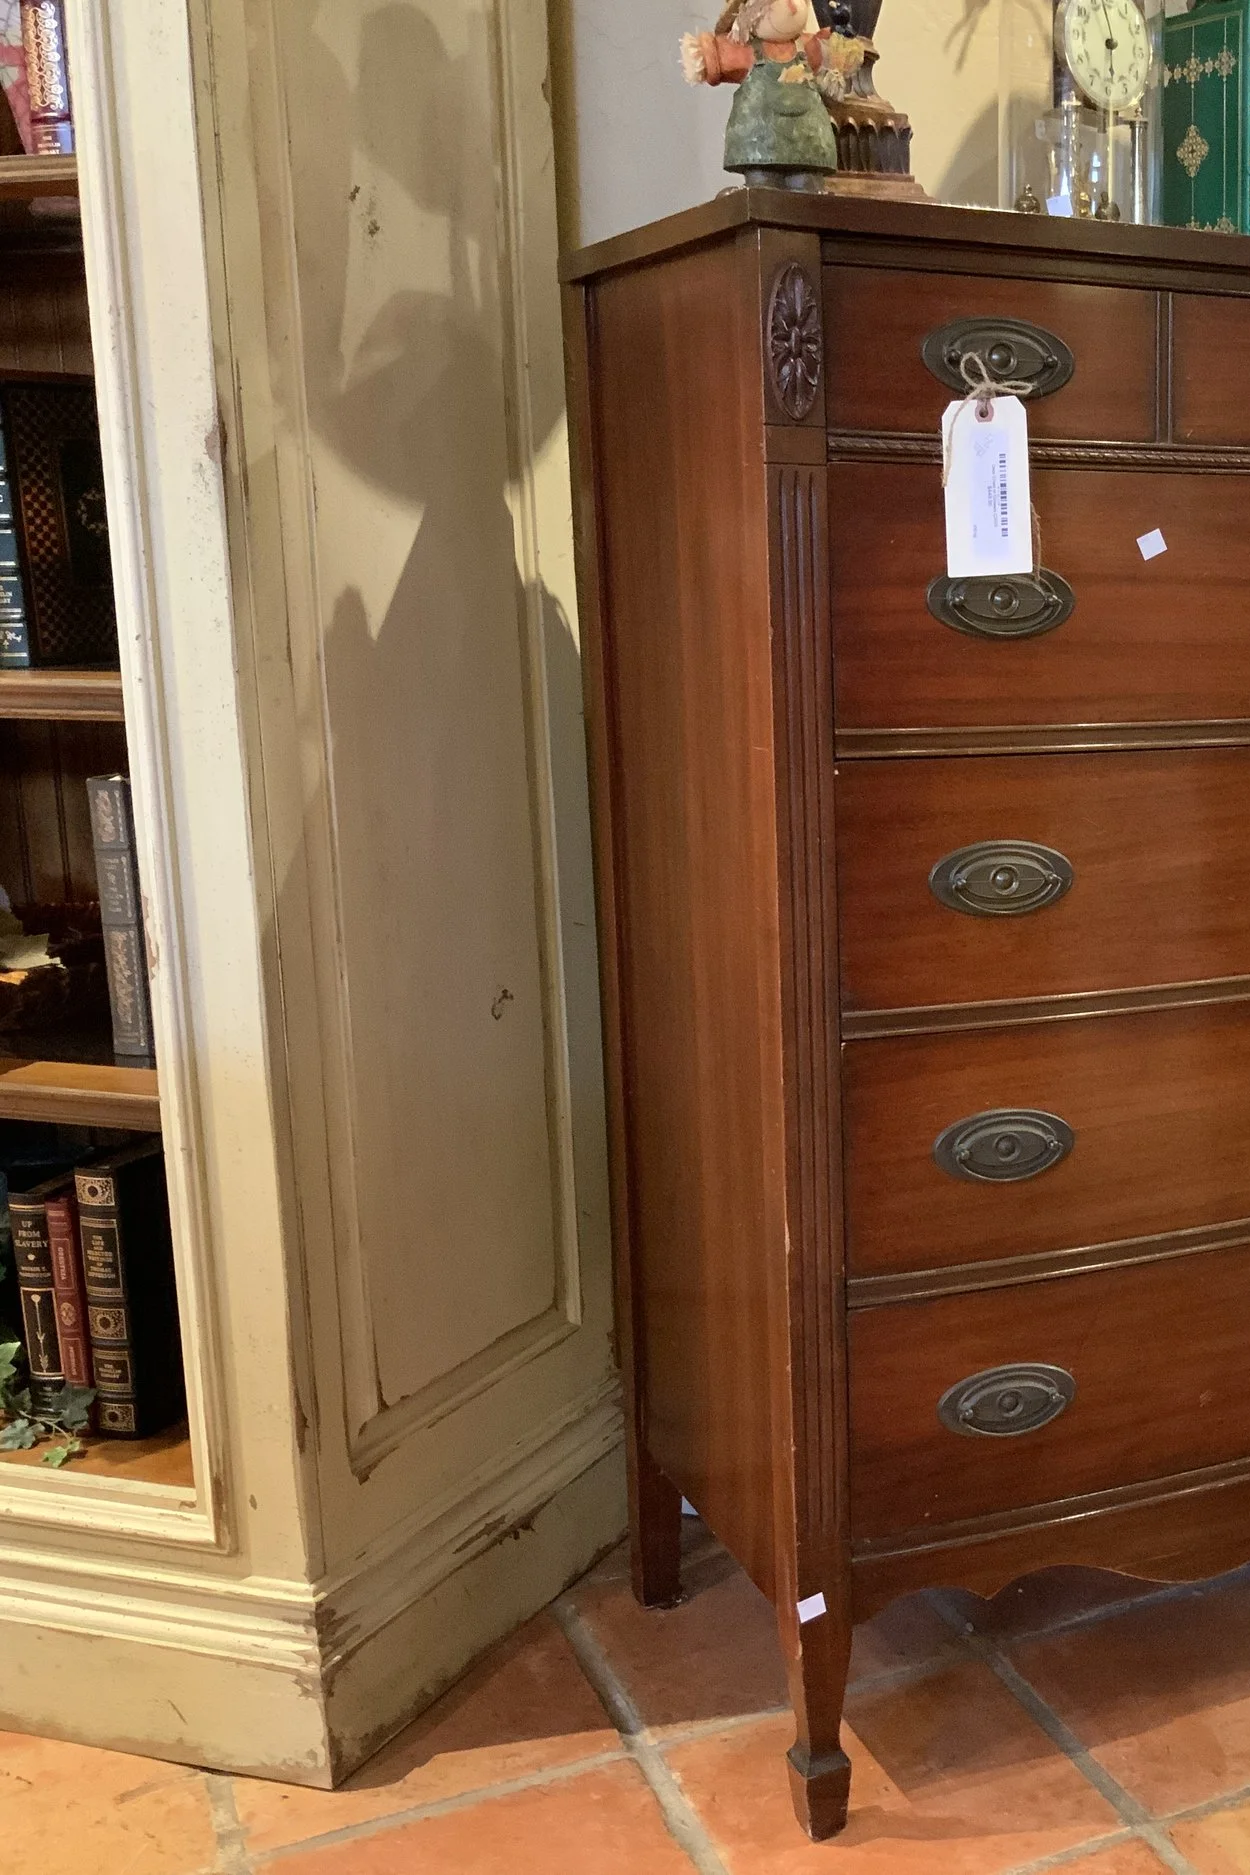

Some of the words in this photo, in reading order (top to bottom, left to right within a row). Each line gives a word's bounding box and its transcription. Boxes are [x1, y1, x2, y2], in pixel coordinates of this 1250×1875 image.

[1077, 5, 1087, 17] 10
[1088, 74, 1095, 87] 7
[1105, 85, 1112, 96] 6
[1122, 83, 1128, 95] 5
[21, 1220, 33, 1228] UP
[18, 1229, 41, 1238] FROM
[14, 1239, 49, 1248] SLAVERY
